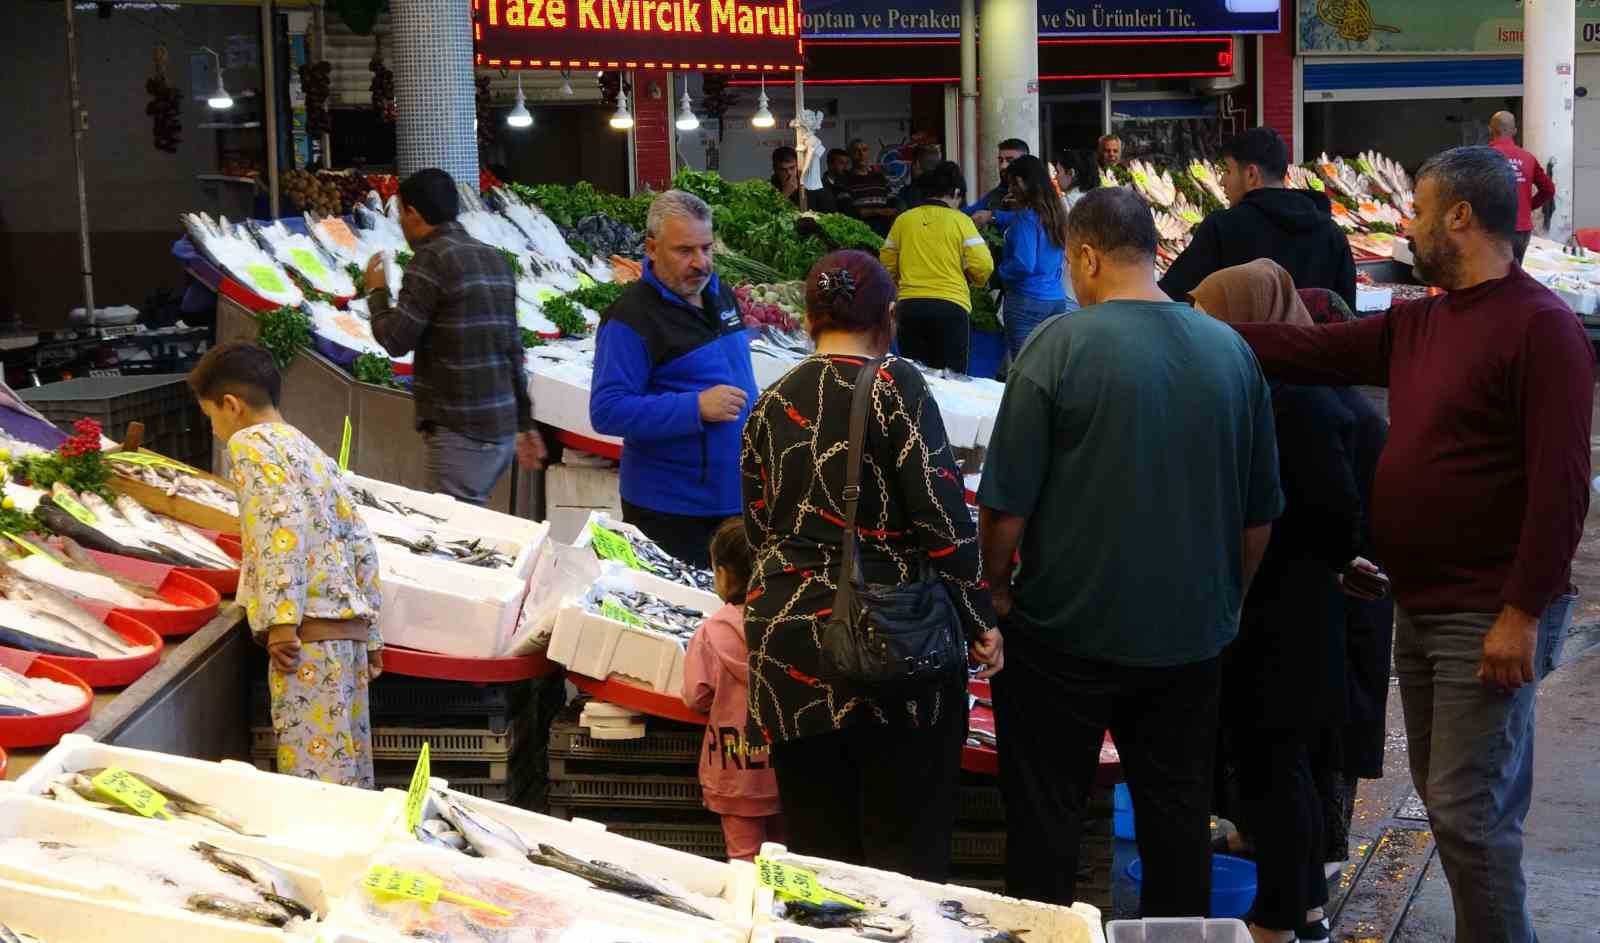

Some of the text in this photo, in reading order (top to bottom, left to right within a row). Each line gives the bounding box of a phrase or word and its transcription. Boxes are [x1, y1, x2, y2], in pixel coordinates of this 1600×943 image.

[487, 0, 567, 28] Taze
[710, 0, 796, 36] Marul
[801, 11, 855, 33] optan
[861, 14, 881, 29] ve
[1042, 4, 1196, 29] ve Su Ürünleri Tic.
